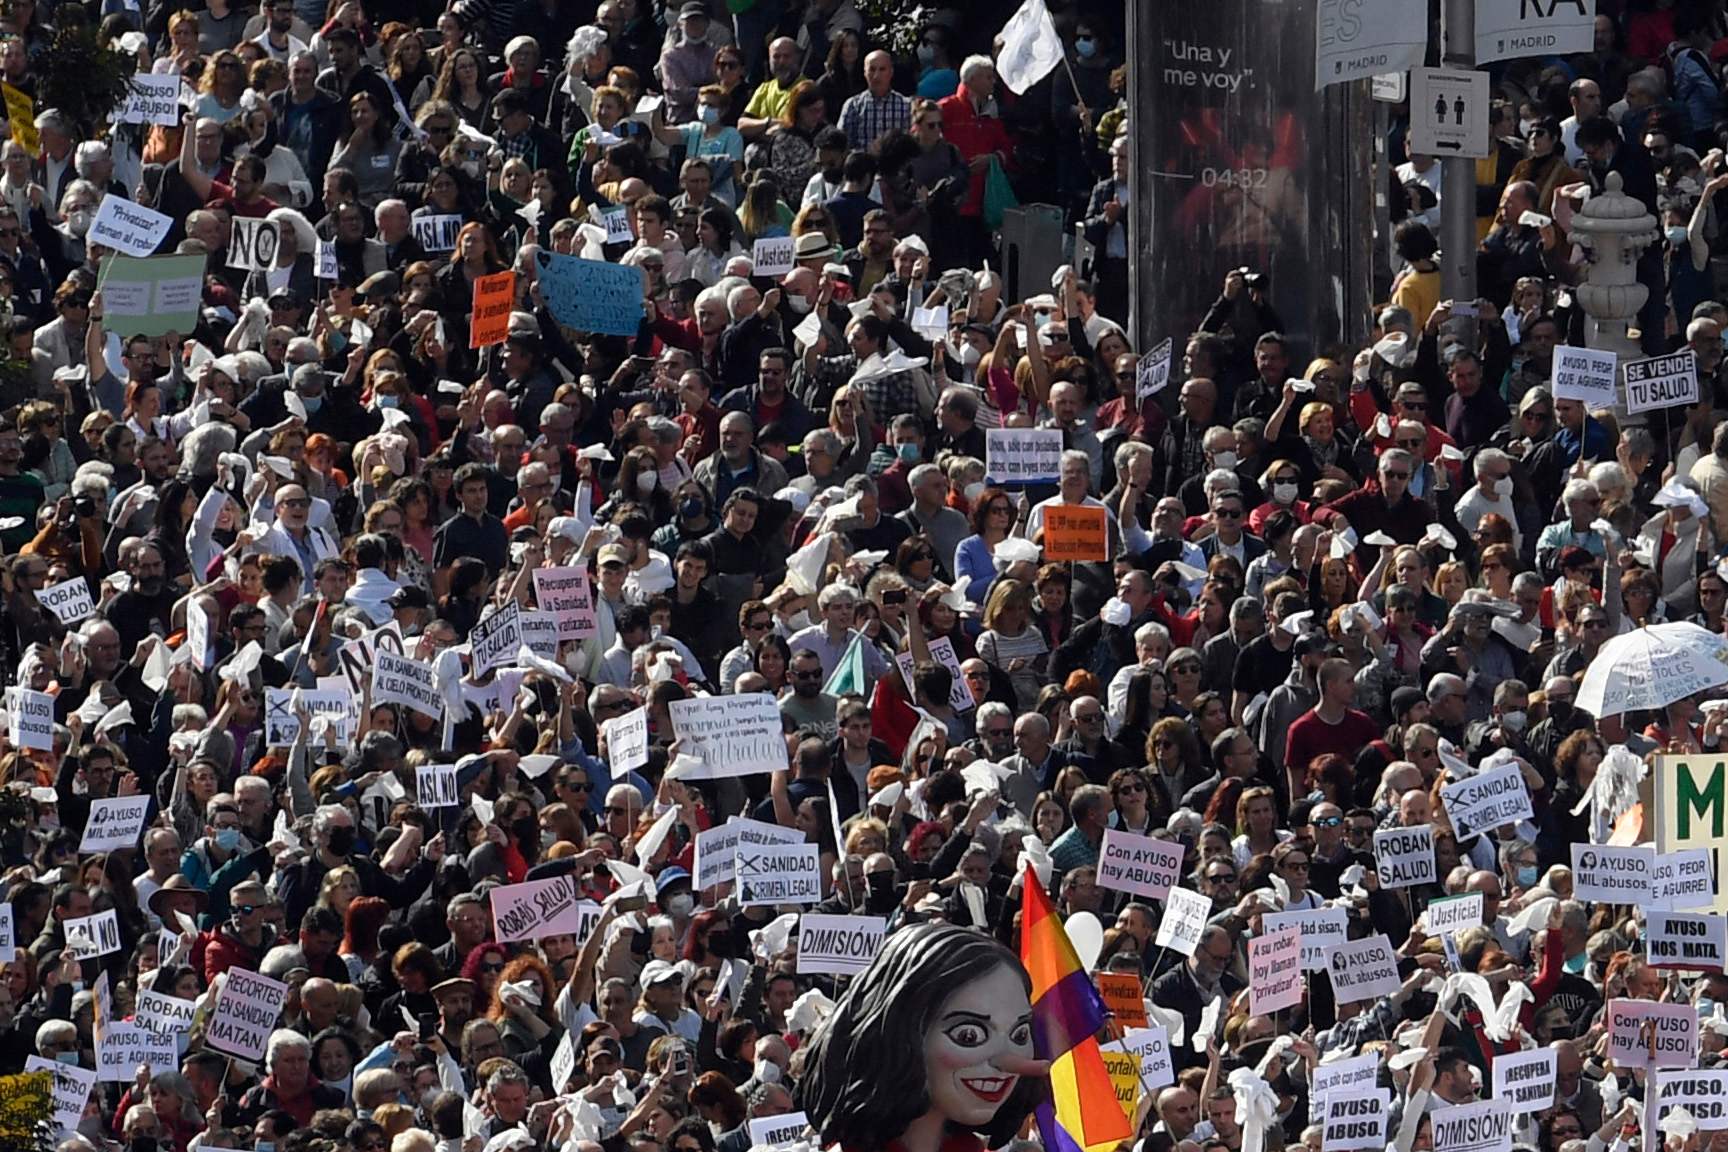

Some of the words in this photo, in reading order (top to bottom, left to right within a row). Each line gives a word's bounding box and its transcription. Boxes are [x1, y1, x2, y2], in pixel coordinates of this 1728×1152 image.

[1510, 35, 1556, 49] MADRID
[1219, 48, 1232, 66] y
[1347, 54, 1388, 70] MADRID
[1164, 68, 1197, 86] me
[230, 221, 279, 269] NO
[1628, 367, 1646, 382] SE
[1648, 355, 1694, 378] VENDE
[1631, 384, 1650, 405] TU
[1651, 377, 1694, 402] SALUD.
[538, 577, 583, 592] Recuperar
[553, 594, 588, 611] Sanidad
[472, 625, 486, 644] SE
[485, 602, 518, 632] VENDE
[379, 655, 394, 672] CON
[476, 646, 489, 668] TU
[441, 770, 456, 803] NO
[1106, 844, 1131, 861] Con
[1133, 851, 1178, 870] AYUSO
[1375, 832, 1431, 862] ¡ROBAN
[762, 856, 819, 875] SANIDAD,
[1101, 863, 1122, 881] hay
[1125, 869, 1177, 889] ABUSO!
[1379, 861, 1433, 884] SALUD!
[1598, 857, 1650, 874] AYUSO,
[1679, 859, 1706, 877] PEOR
[754, 881, 786, 898] CRIMEN
[787, 879, 819, 898] LEGAL!
[1577, 872, 1599, 888] MIL
[1601, 874, 1652, 891] abusos.
[1662, 880, 1708, 897] AGUIRRE!
[1430, 901, 1481, 929] ¡Justicia!
[100, 917, 118, 952] NO
[1317, 920, 1344, 937] sisan,
[1664, 920, 1707, 937] AYUSO
[1253, 944, 1260, 959] A
[1260, 942, 1272, 956] su
[1273, 934, 1296, 954] robar,
[1651, 940, 1678, 957] NOS
[1682, 942, 1721, 960] MATA.
[1348, 948, 1391, 968] AYUSO,
[1253, 963, 1269, 982] hoy
[1270, 956, 1297, 975] llaman
[1335, 973, 1356, 990] MIL
[1358, 967, 1398, 985] abusos.
[225, 971, 283, 1007] RECORTES
[137, 995, 195, 1022] ¡ROBAN
[217, 997, 232, 1014] EN
[232, 1001, 275, 1030] SANIDAD
[1613, 1013, 1640, 1029] Con
[101, 1032, 142, 1049] ¡AYUSO,
[146, 1031, 173, 1047] PEOR
[210, 1019, 264, 1052] MATAN.
[1611, 1035, 1633, 1051] hay
[102, 1049, 124, 1066] QUE
[128, 1050, 173, 1066] AGUIRRE!
[1504, 1060, 1551, 1085] ¡RECUPERA
[1662, 1079, 1727, 1099] AYUSO,
[1330, 1098, 1383, 1119] AYUSO,
[1326, 1121, 1382, 1142] ABUSO.
[1435, 1108, 1508, 1147] DIMISIÓN!
